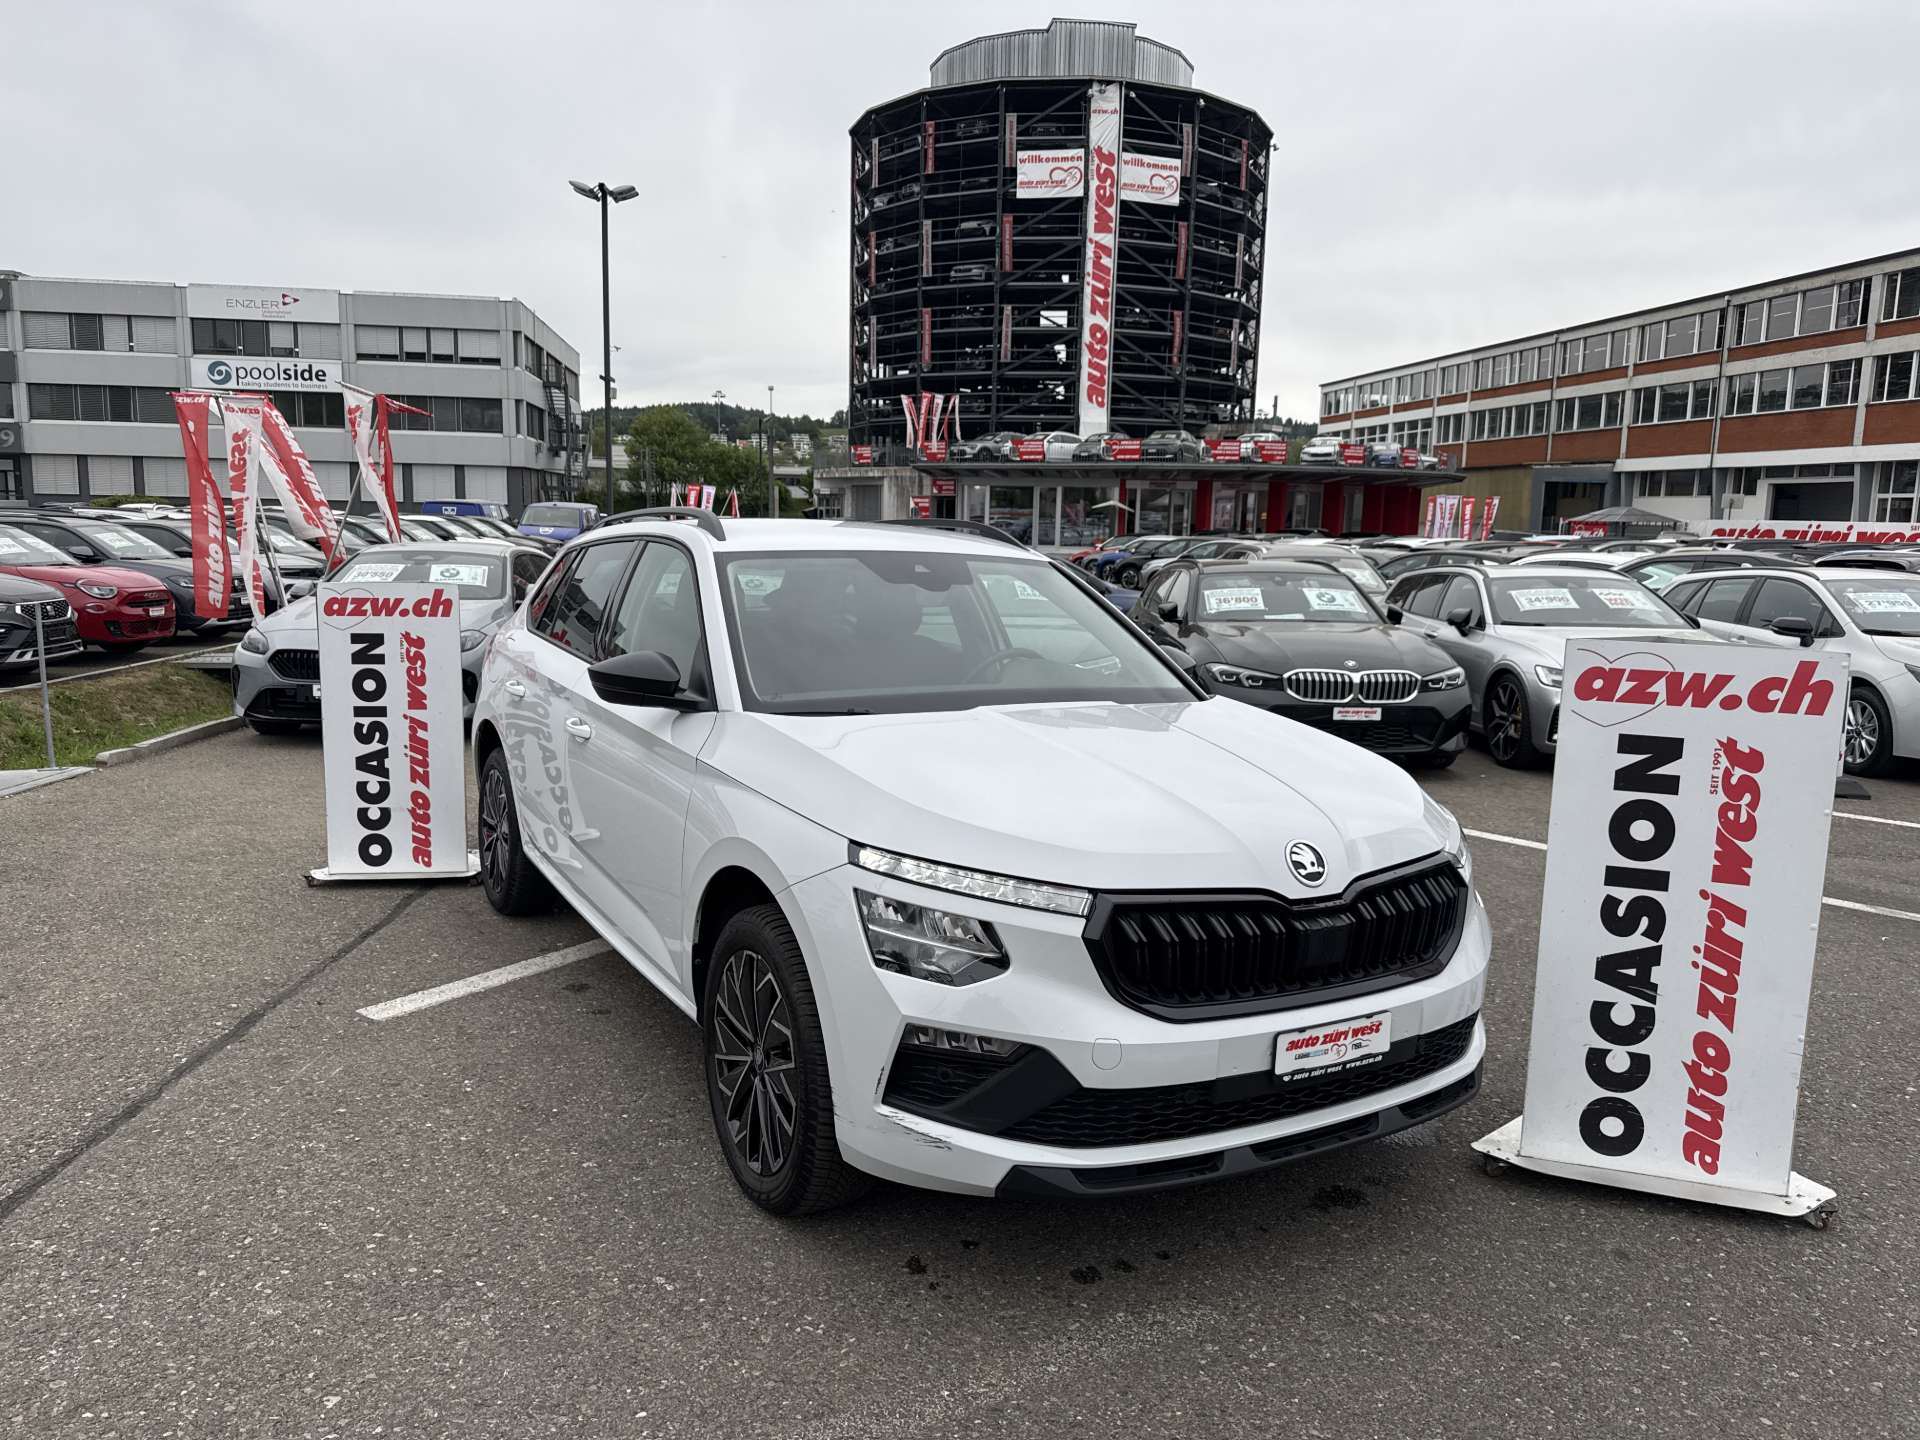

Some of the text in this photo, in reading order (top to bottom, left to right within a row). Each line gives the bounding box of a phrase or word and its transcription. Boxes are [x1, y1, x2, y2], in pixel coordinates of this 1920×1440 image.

[1018, 154, 1083, 165] willkommen
[1122, 157, 1180, 172] willkommen
[1084, 145, 1117, 409] auto züri west
[226, 298, 280, 310] ENZLER
[235, 362, 328, 387] poolside
[300, 382, 328, 390] business
[206, 542, 225, 609] auto
[323, 588, 453, 618] azw.ch
[1573, 660, 1834, 717] azw.ch
[350, 632, 393, 868] OCCASION
[401, 630, 433, 869] auto züri west
[1710, 747, 1722, 795] SEIT 1991
[1578, 732, 1685, 1157] OCCASION
[1681, 735, 1765, 1176] auto züri west
[1286, 1033, 1320, 1052] auto
[1320, 1026, 1352, 1046] züri
[1352, 1020, 1383, 1039] west
[1293, 1072, 1309, 1081] auto
